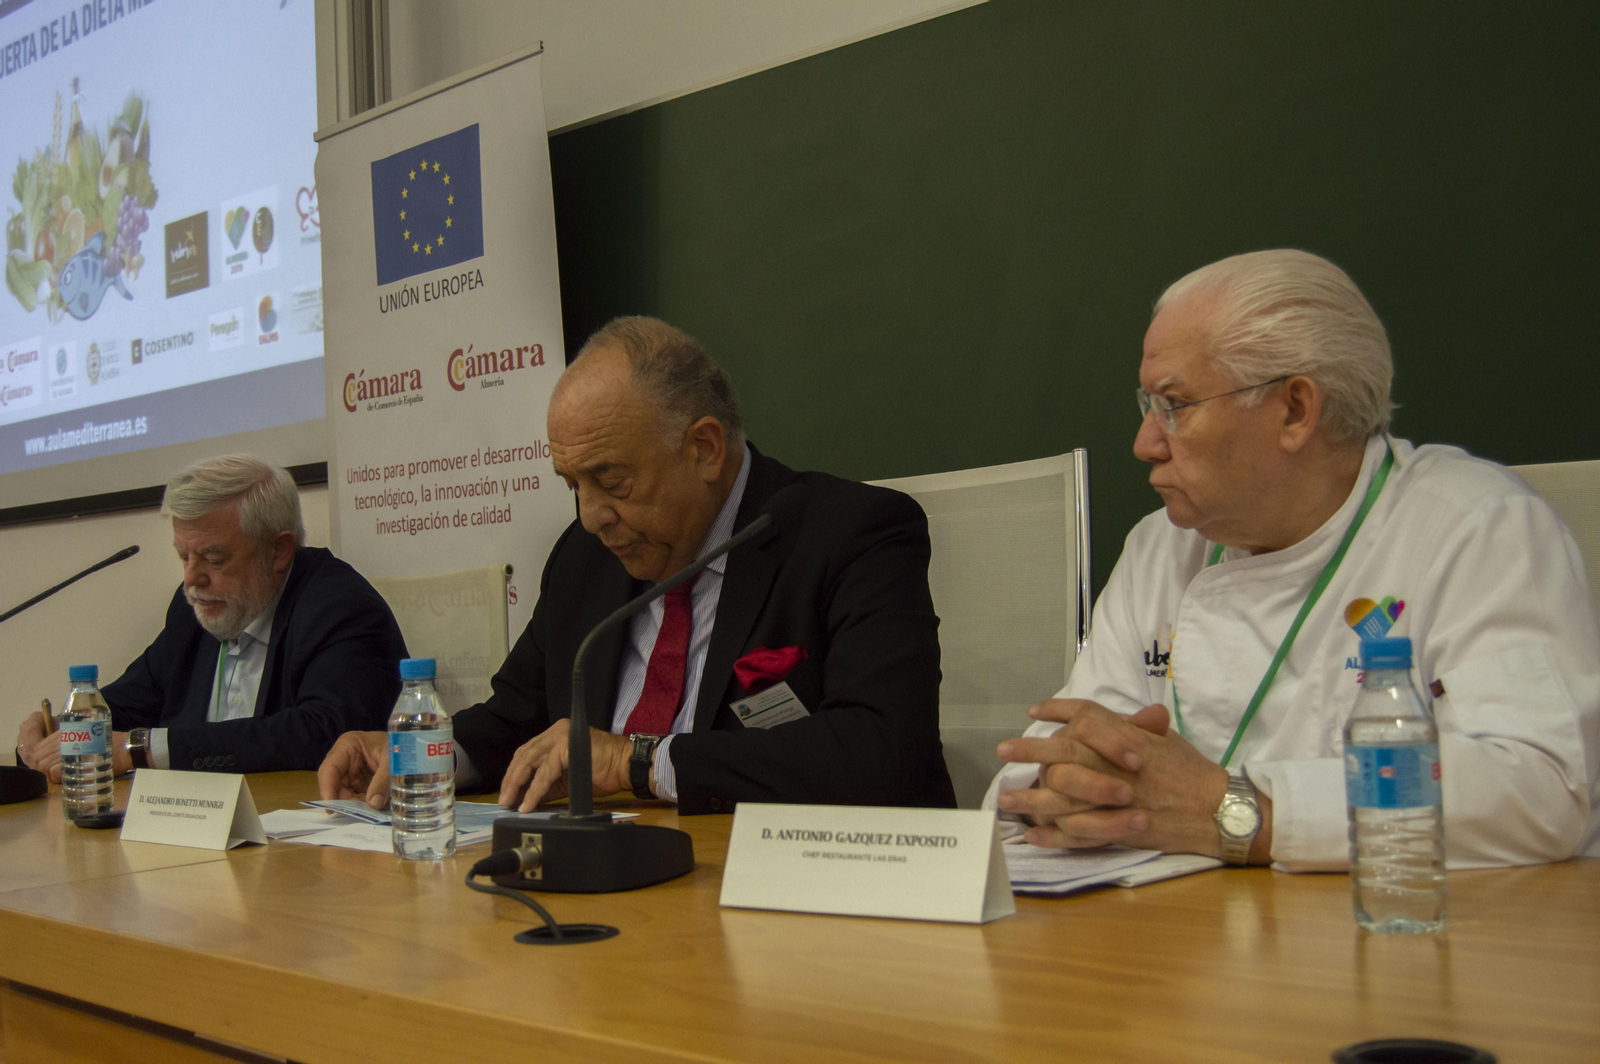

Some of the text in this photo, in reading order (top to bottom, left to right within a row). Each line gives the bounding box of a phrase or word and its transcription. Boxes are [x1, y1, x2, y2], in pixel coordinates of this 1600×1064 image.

[41, 19, 59, 58] DE
[62, 10, 79, 47] LA
[83, 0, 124, 37] DIETA
[379, 269, 484, 314] UNIÓN EUROPEA
[145, 331, 194, 356] COSENTINO
[447, 343, 546, 391] Cámara
[480, 377, 505, 390] Almería
[343, 368, 422, 412] Cámara
[25, 416, 148, 456] www.aulamediterranea.es
[346, 440, 551, 484] Unidos para promover el desarrollo
[354, 475, 540, 510] tecnológico, la innovación y una
[376, 503, 512, 536] investigación de calidad
[761, 828, 958, 849] D. ANTONIO GAZQUEZ EXPOSITO
[802, 850, 820, 859] CHEF
[821, 852, 872, 862] RESTAURANTE
